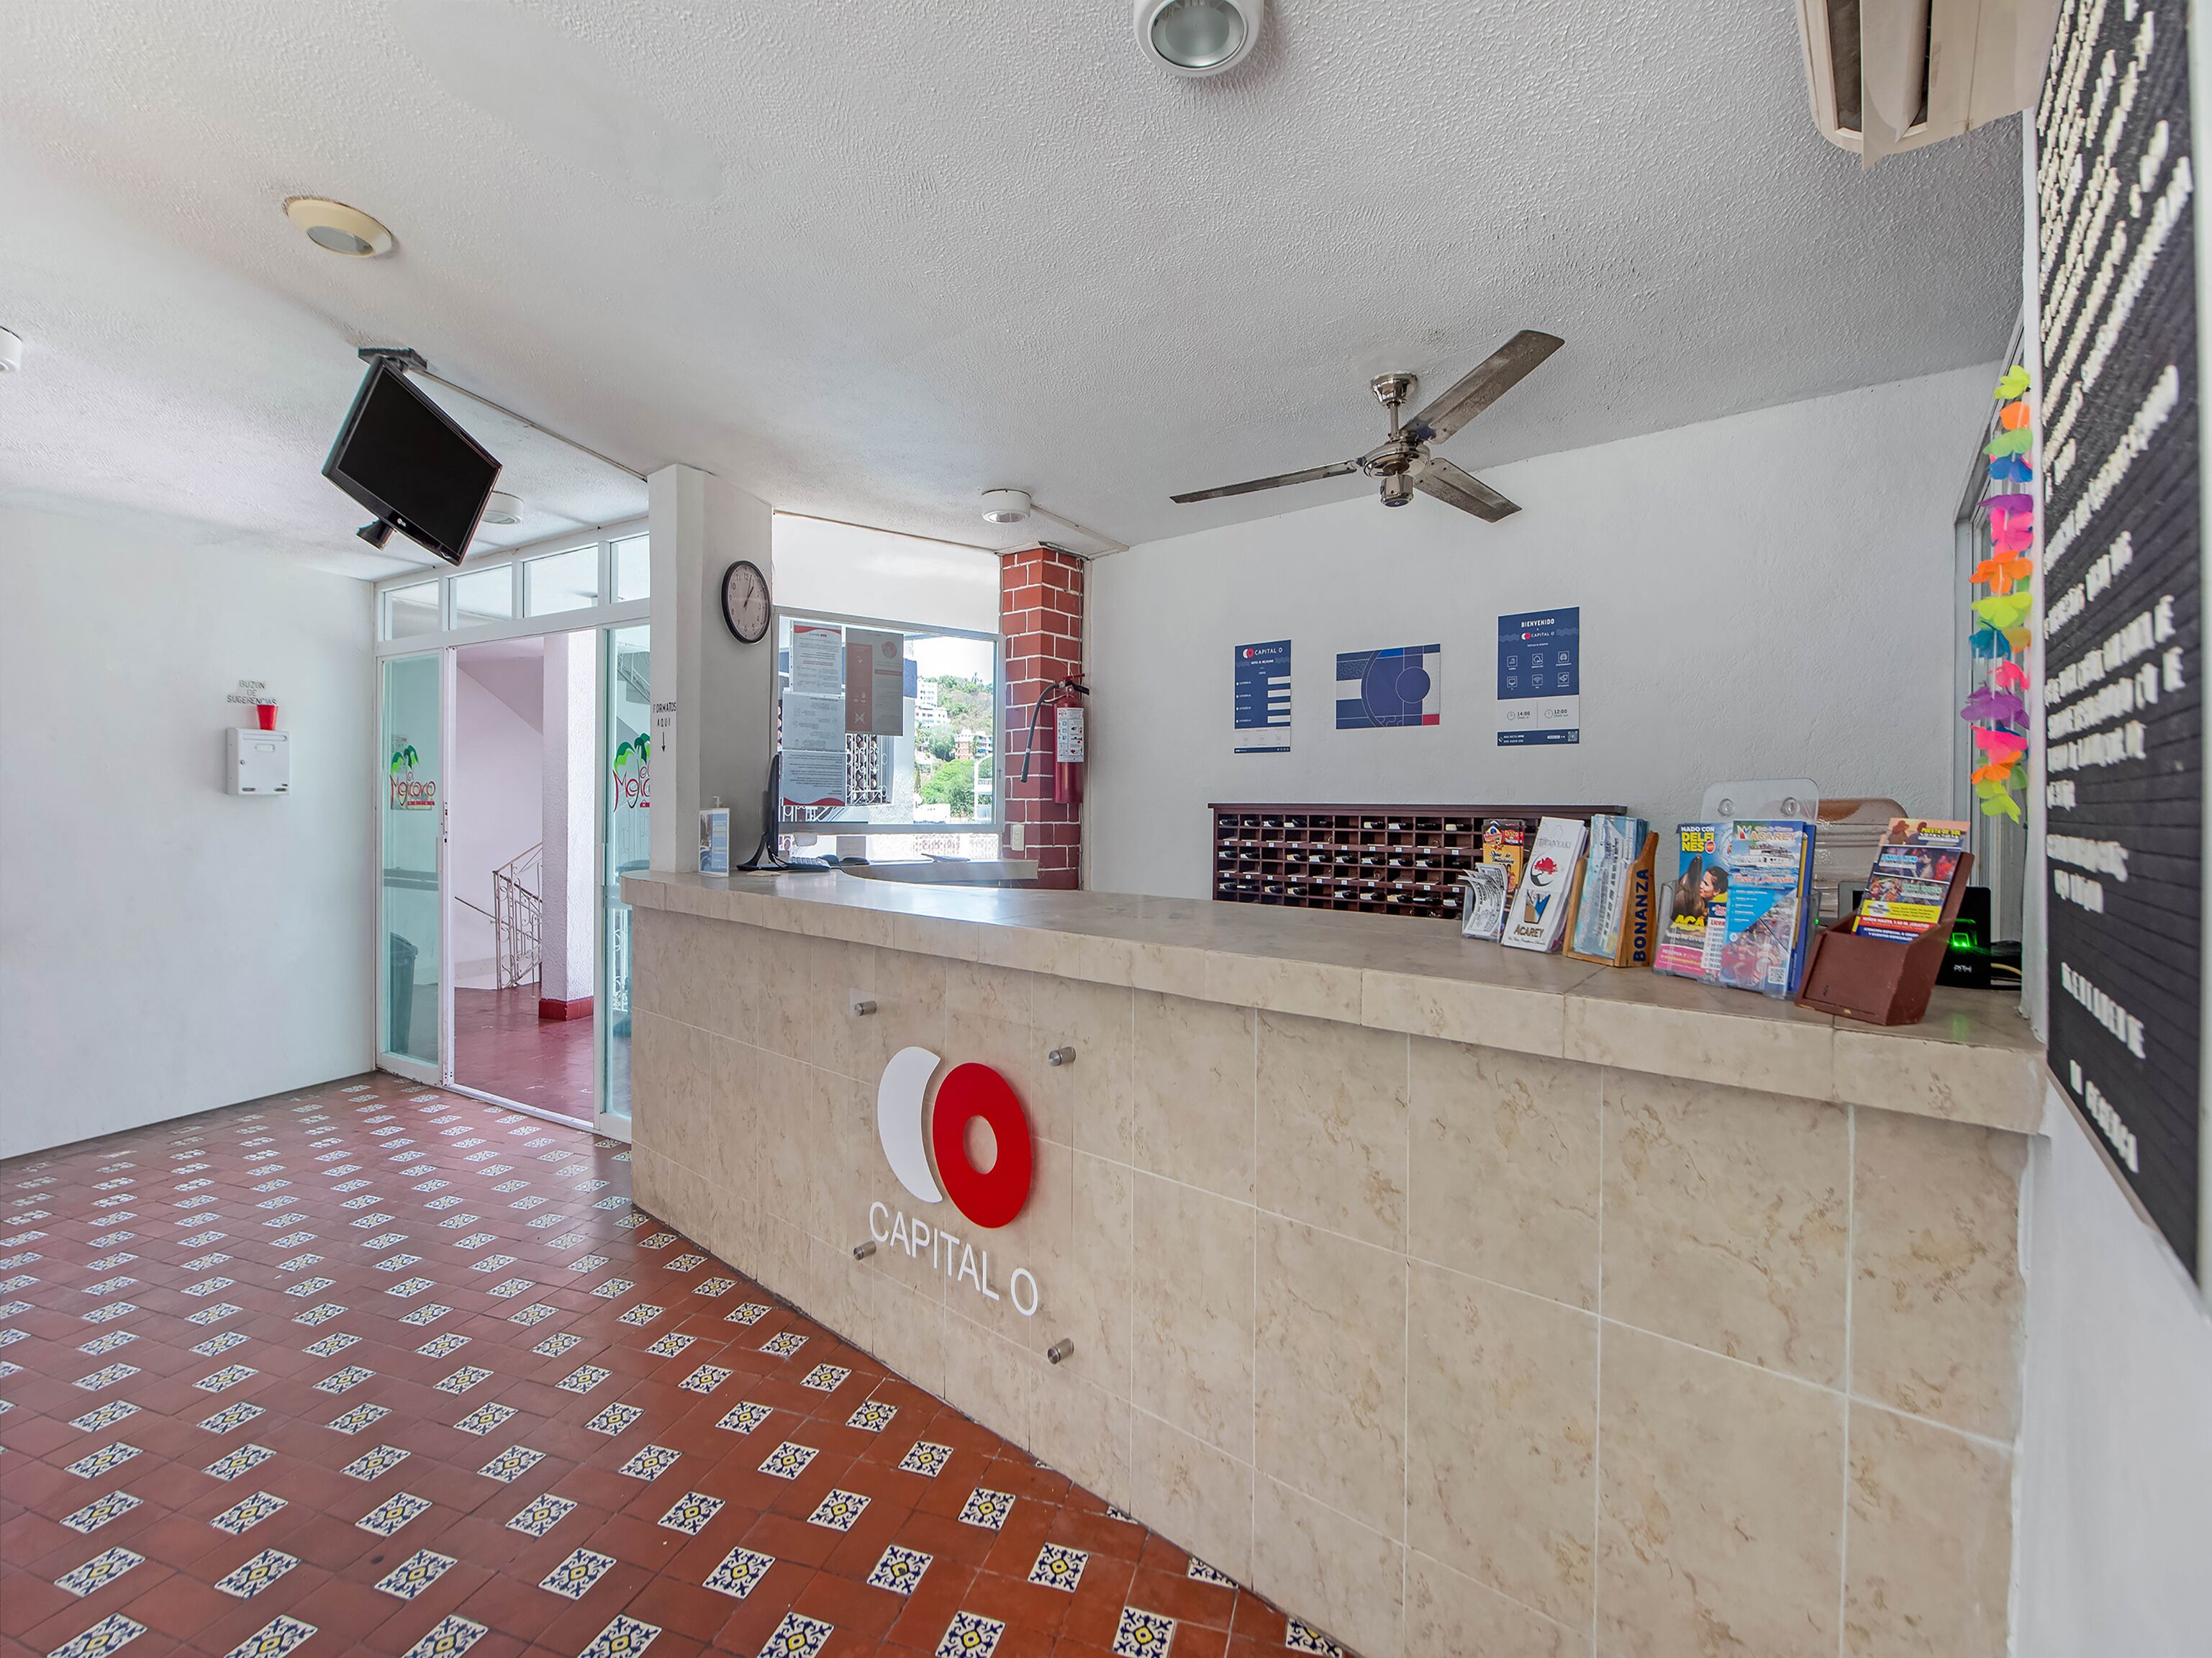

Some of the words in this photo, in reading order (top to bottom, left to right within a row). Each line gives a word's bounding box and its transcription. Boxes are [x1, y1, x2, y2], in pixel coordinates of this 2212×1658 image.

[1520, 618, 1554, 628] BIENVENIDO
[246, 688, 257, 697] DE
[227, 695, 277, 705] SUGERENCIAS
[653, 702, 676, 714] FORMATOS
[657, 717, 671, 728] AQUI
[1681, 832, 1715, 842] DELFI
[1749, 830, 1797, 841] ACAREY
[1681, 841, 1705, 852] NES
[1633, 868, 1649, 963] BONANZA
[1514, 924, 1544, 938] ACAREY
[869, 1201, 1000, 1301] CAPITAL
[1010, 1267, 1038, 1317] O
